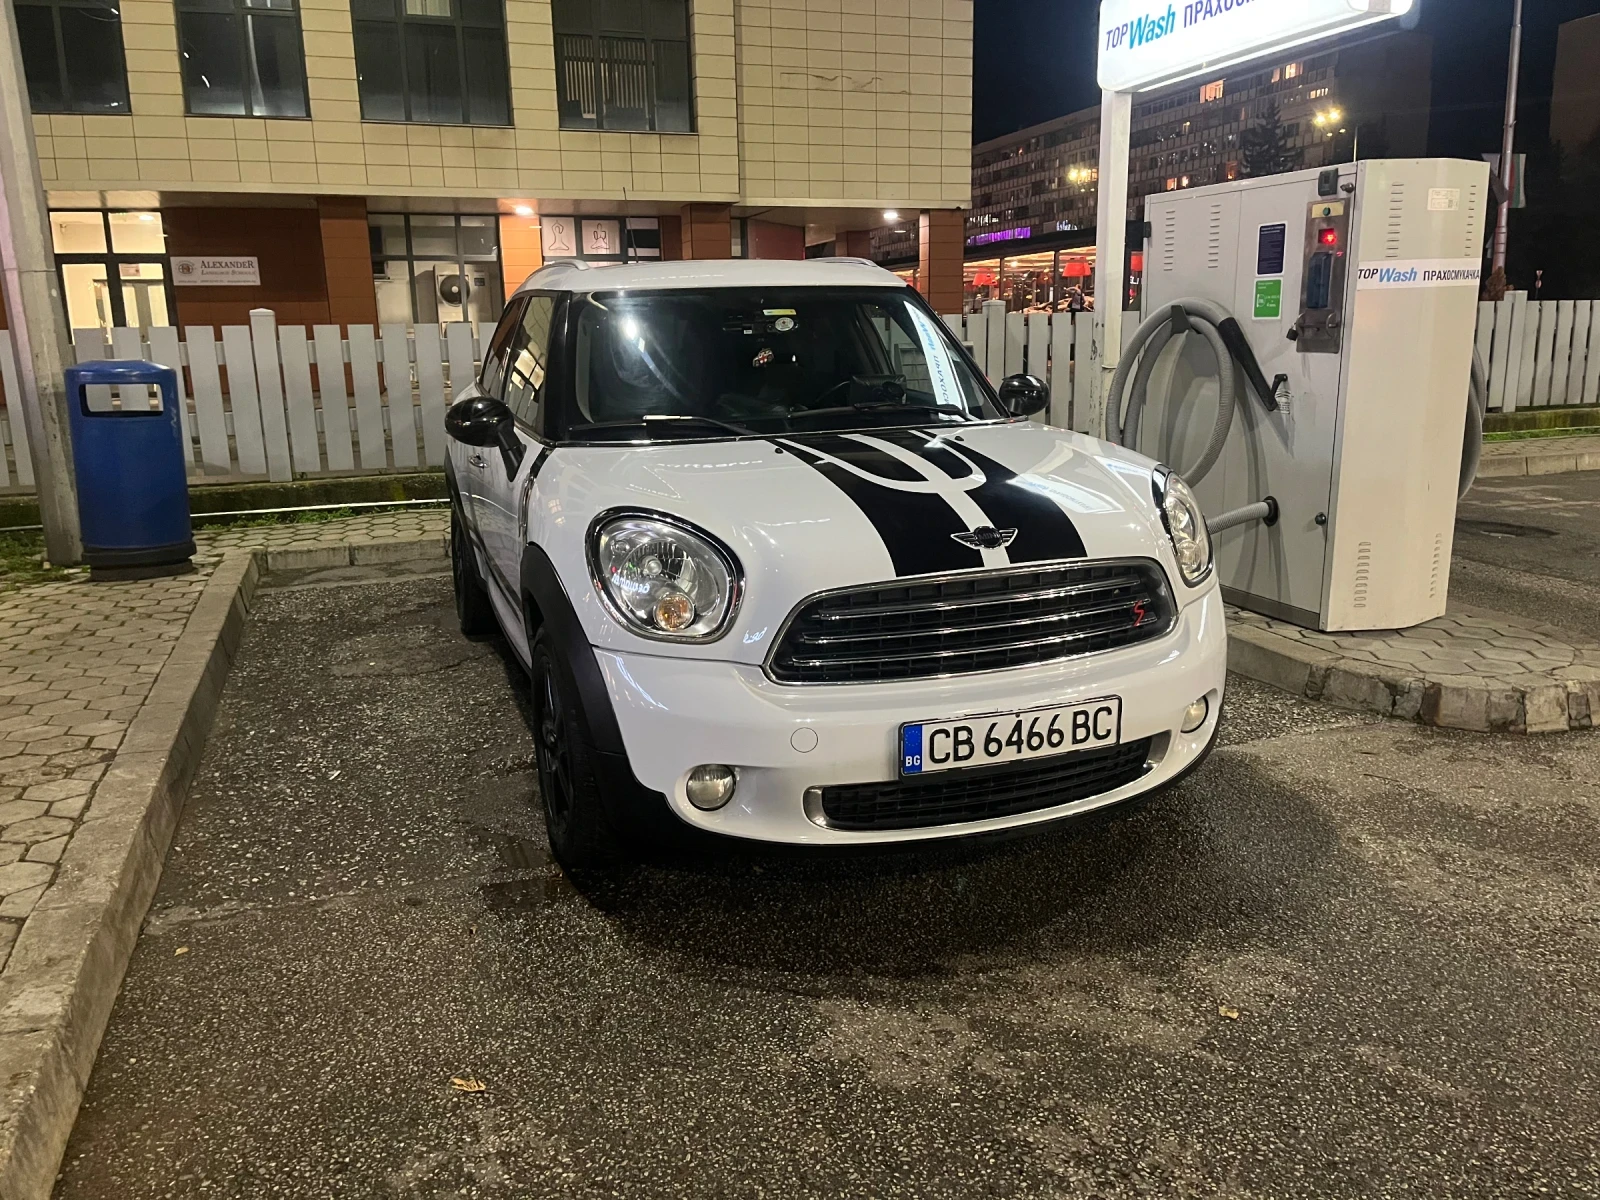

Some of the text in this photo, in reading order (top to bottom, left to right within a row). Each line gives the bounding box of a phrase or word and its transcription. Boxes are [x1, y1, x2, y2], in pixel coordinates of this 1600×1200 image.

[200, 260, 255, 269] ALEXANDER
[1423, 269, 1480, 281] ПРАХОСМУКАЧКА
[905, 705, 1113, 768] BG CB 6466 BC
